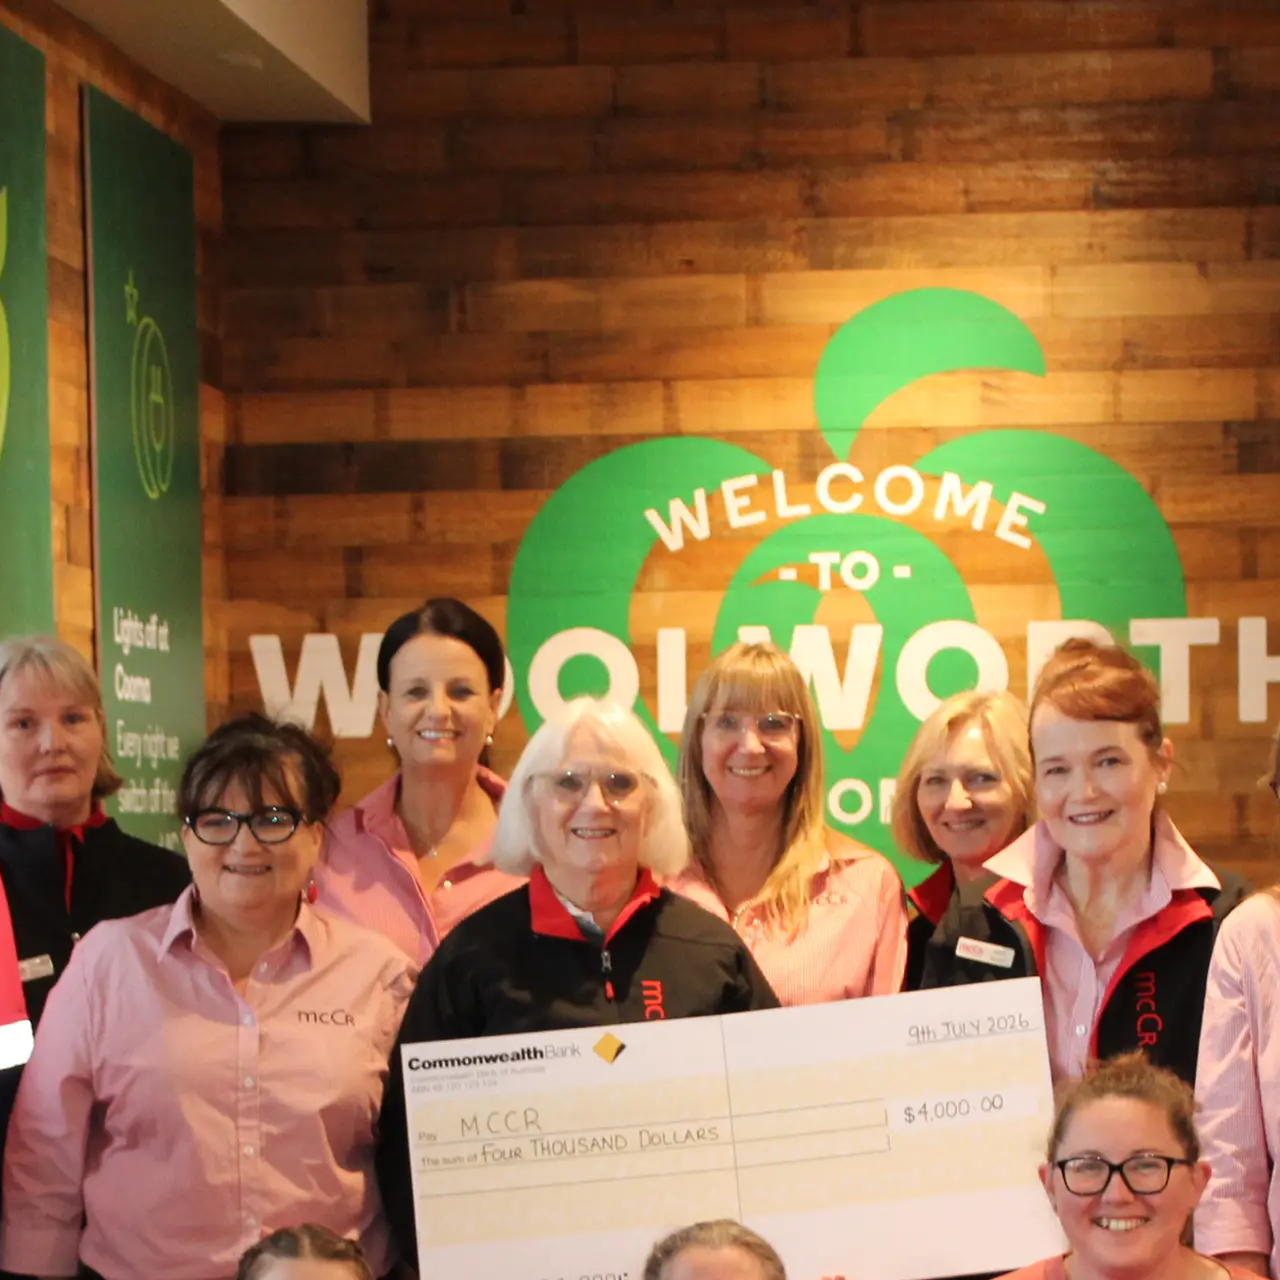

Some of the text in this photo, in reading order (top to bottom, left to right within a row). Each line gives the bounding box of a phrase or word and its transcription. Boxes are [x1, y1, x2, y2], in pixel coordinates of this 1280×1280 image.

[644, 462, 1047, 552] WELCOME
[114, 606, 145, 655] Lights
[114, 662, 152, 704] Cooma
[116, 718, 142, 769] Every
[143, 724, 167, 769] night
[908, 1012, 1030, 1043] 9th JULY 2026
[530, 1132, 628, 1158] THOUSAND
[639, 1126, 720, 1149] DOLLARS
